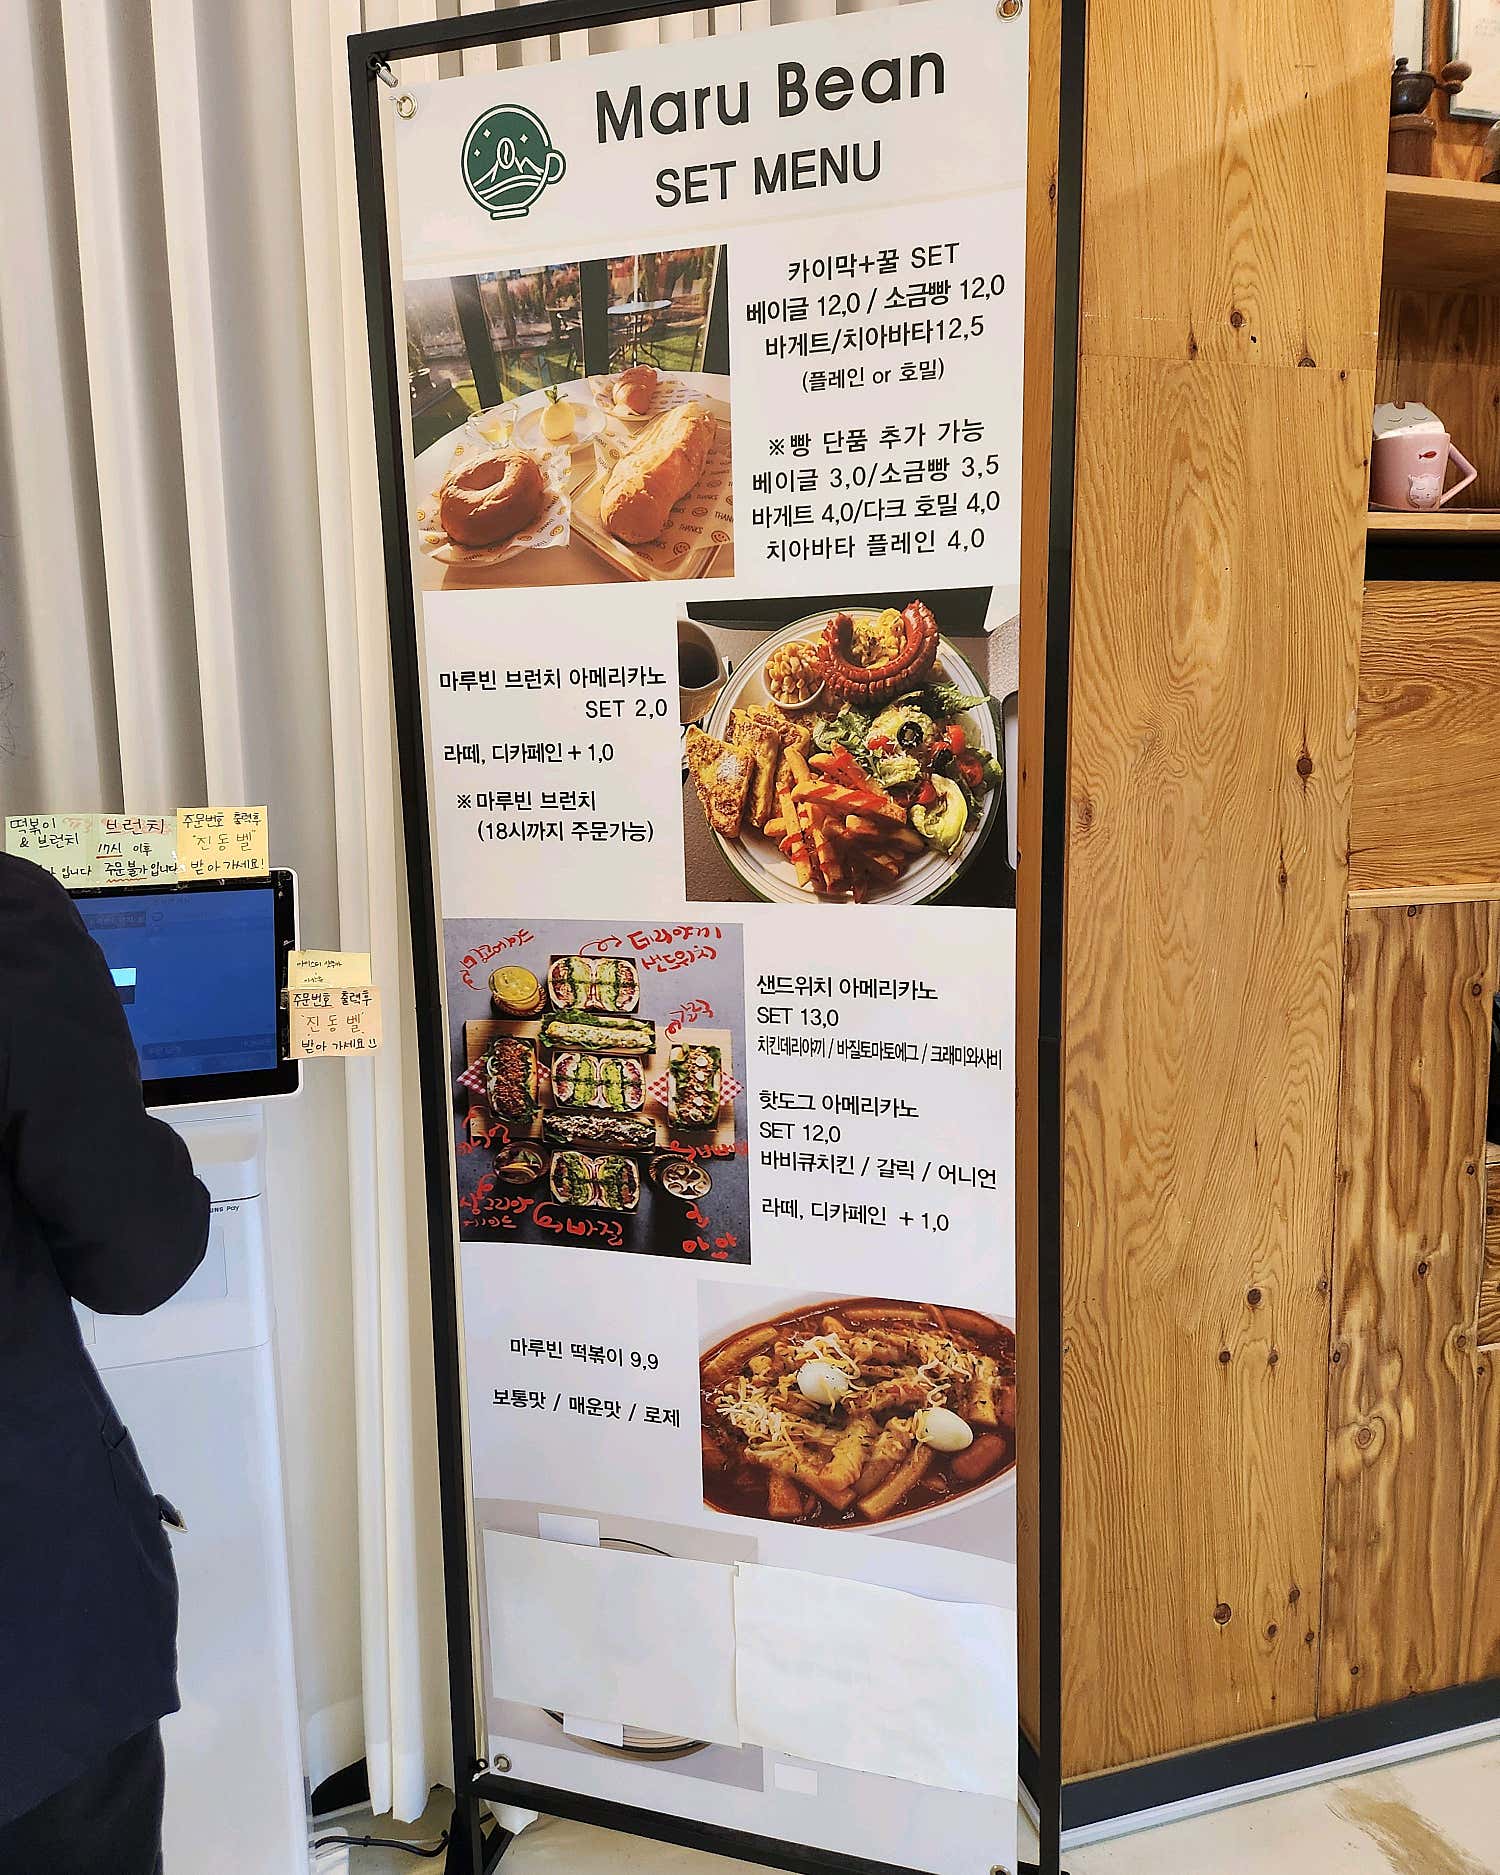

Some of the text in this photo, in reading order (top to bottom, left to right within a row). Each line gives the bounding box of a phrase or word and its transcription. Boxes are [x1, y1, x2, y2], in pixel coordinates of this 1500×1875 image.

[596, 53, 944, 143] Maru Bean
[656, 140, 880, 207] SET MENU
[789, 243, 959, 283] 카이막+꿀 SET
[747, 297, 809, 324] 베이글
[818, 293, 860, 317] 12,0
[884, 280, 951, 308] 소금빵
[960, 275, 1004, 300] 12,0
[803, 358, 944, 393] (플레인 or 호밀)
[824, 429, 868, 454] 단품
[880, 423, 925, 449] 추가
[938, 419, 984, 443] 가능
[753, 469, 818, 494] 베이글
[962, 455, 998, 479] 3,5
[753, 505, 814, 528] 바게트
[915, 493, 957, 516] 호밀
[967, 491, 999, 514] 4,0
[767, 528, 984, 561] 치아바타 플레인 4,0
[440, 666, 666, 691] 마루빈 브런치 아메리카노
[586, 699, 667, 719] SET 2,0
[444, 744, 485, 764] 라떼,
[493, 743, 562, 763] 디카페인
[540, 791, 595, 811] 브런치
[10, 817, 56, 835] 떡볶이
[105, 818, 165, 835] 브런치
[183, 812, 224, 828] 주문번호
[478, 821, 653, 842] (18시까지 주문가능)
[20, 832, 79, 848] & 브런치
[133, 843, 152, 856] 이후
[191, 860, 221, 875] 받아
[293, 990, 372, 1008] 주문번호 출력후
[757, 975, 938, 1000] 샌드위치 아메리카노
[757, 1007, 838, 1028] SET 13,0
[301, 1040, 328, 1054] 받아
[758, 1036, 825, 1057] 치킨데리야끼
[837, 1039, 919, 1062] 바질토마토에그
[931, 1046, 1001, 1070] 크래미와사비
[759, 1090, 919, 1118] 핫도그 아메리카노
[760, 1122, 840, 1144] SET 12,0
[761, 1150, 854, 1175] 바비큐치킨
[877, 1159, 913, 1180] 갈릭
[939, 1165, 996, 1189] 어니언
[763, 1198, 803, 1220] 라떼,
[812, 1202, 886, 1225] 디카페인
[511, 1338, 658, 1370] 마루빈 떡볶이 9,9
[493, 1390, 546, 1409] 보통맛
[569, 1397, 621, 1419] 매운맛
[644, 1407, 679, 1427] 로제
